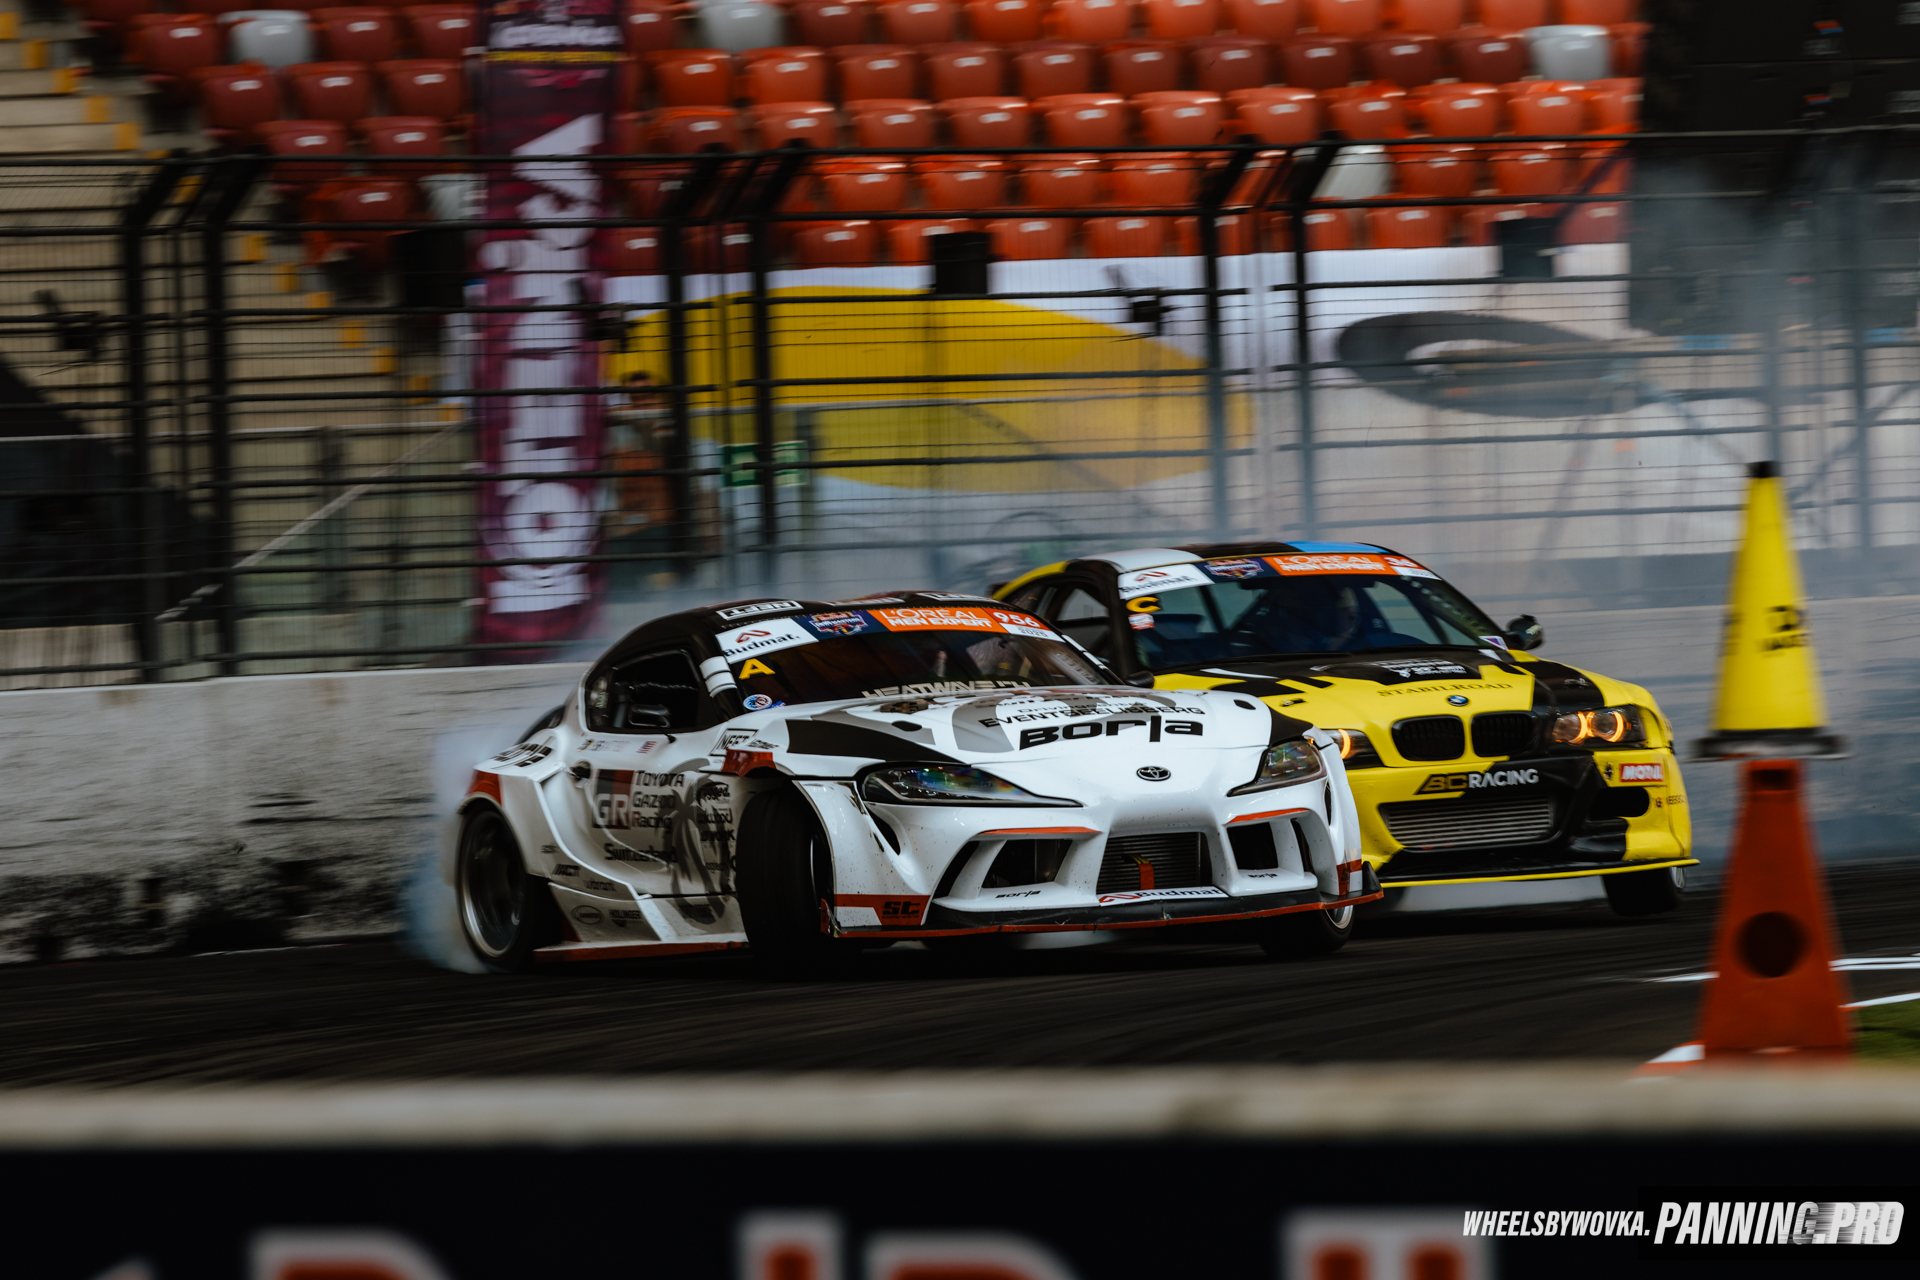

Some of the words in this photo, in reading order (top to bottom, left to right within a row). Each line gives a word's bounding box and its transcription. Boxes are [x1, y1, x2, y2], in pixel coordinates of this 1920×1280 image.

[1126, 596, 1161, 613] C
[879, 609, 981, 619] L'ORÉAL
[992, 612, 1041, 628] 956
[887, 618, 930, 627] MEN
[930, 618, 992, 628] EXPERT
[738, 658, 776, 680] A
[1377, 683, 1513, 697] STABILROAD
[1019, 715, 1203, 750] Borja
[635, 770, 685, 787] TOYOTA
[1468, 768, 1539, 788] RACING
[594, 793, 629, 826] GR
